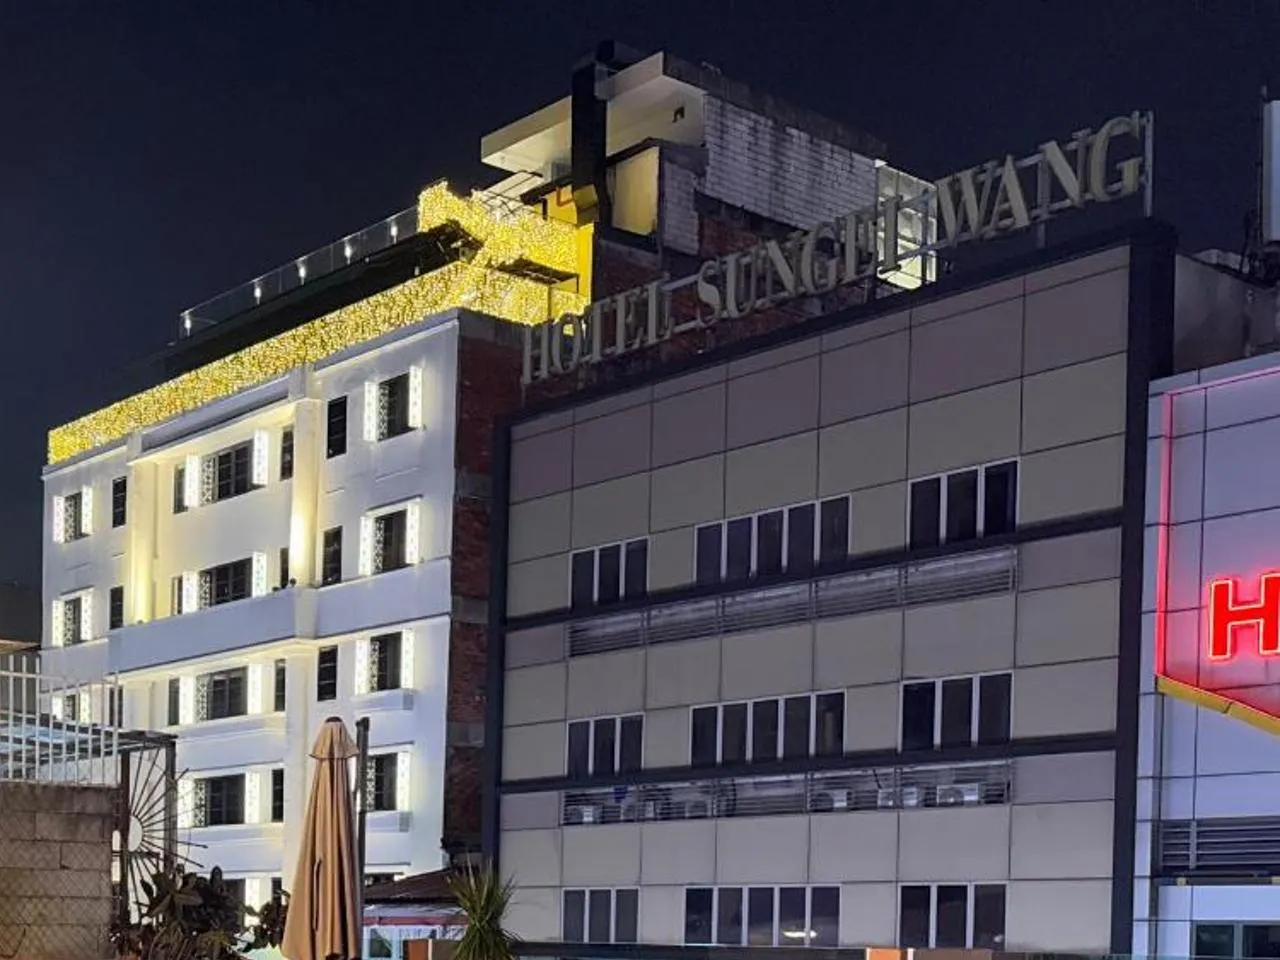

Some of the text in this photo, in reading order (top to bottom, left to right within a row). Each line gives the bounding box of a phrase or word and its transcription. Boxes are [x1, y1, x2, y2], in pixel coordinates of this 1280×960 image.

[522, 111, 1144, 385] HOTEL SUNGEI WANG
